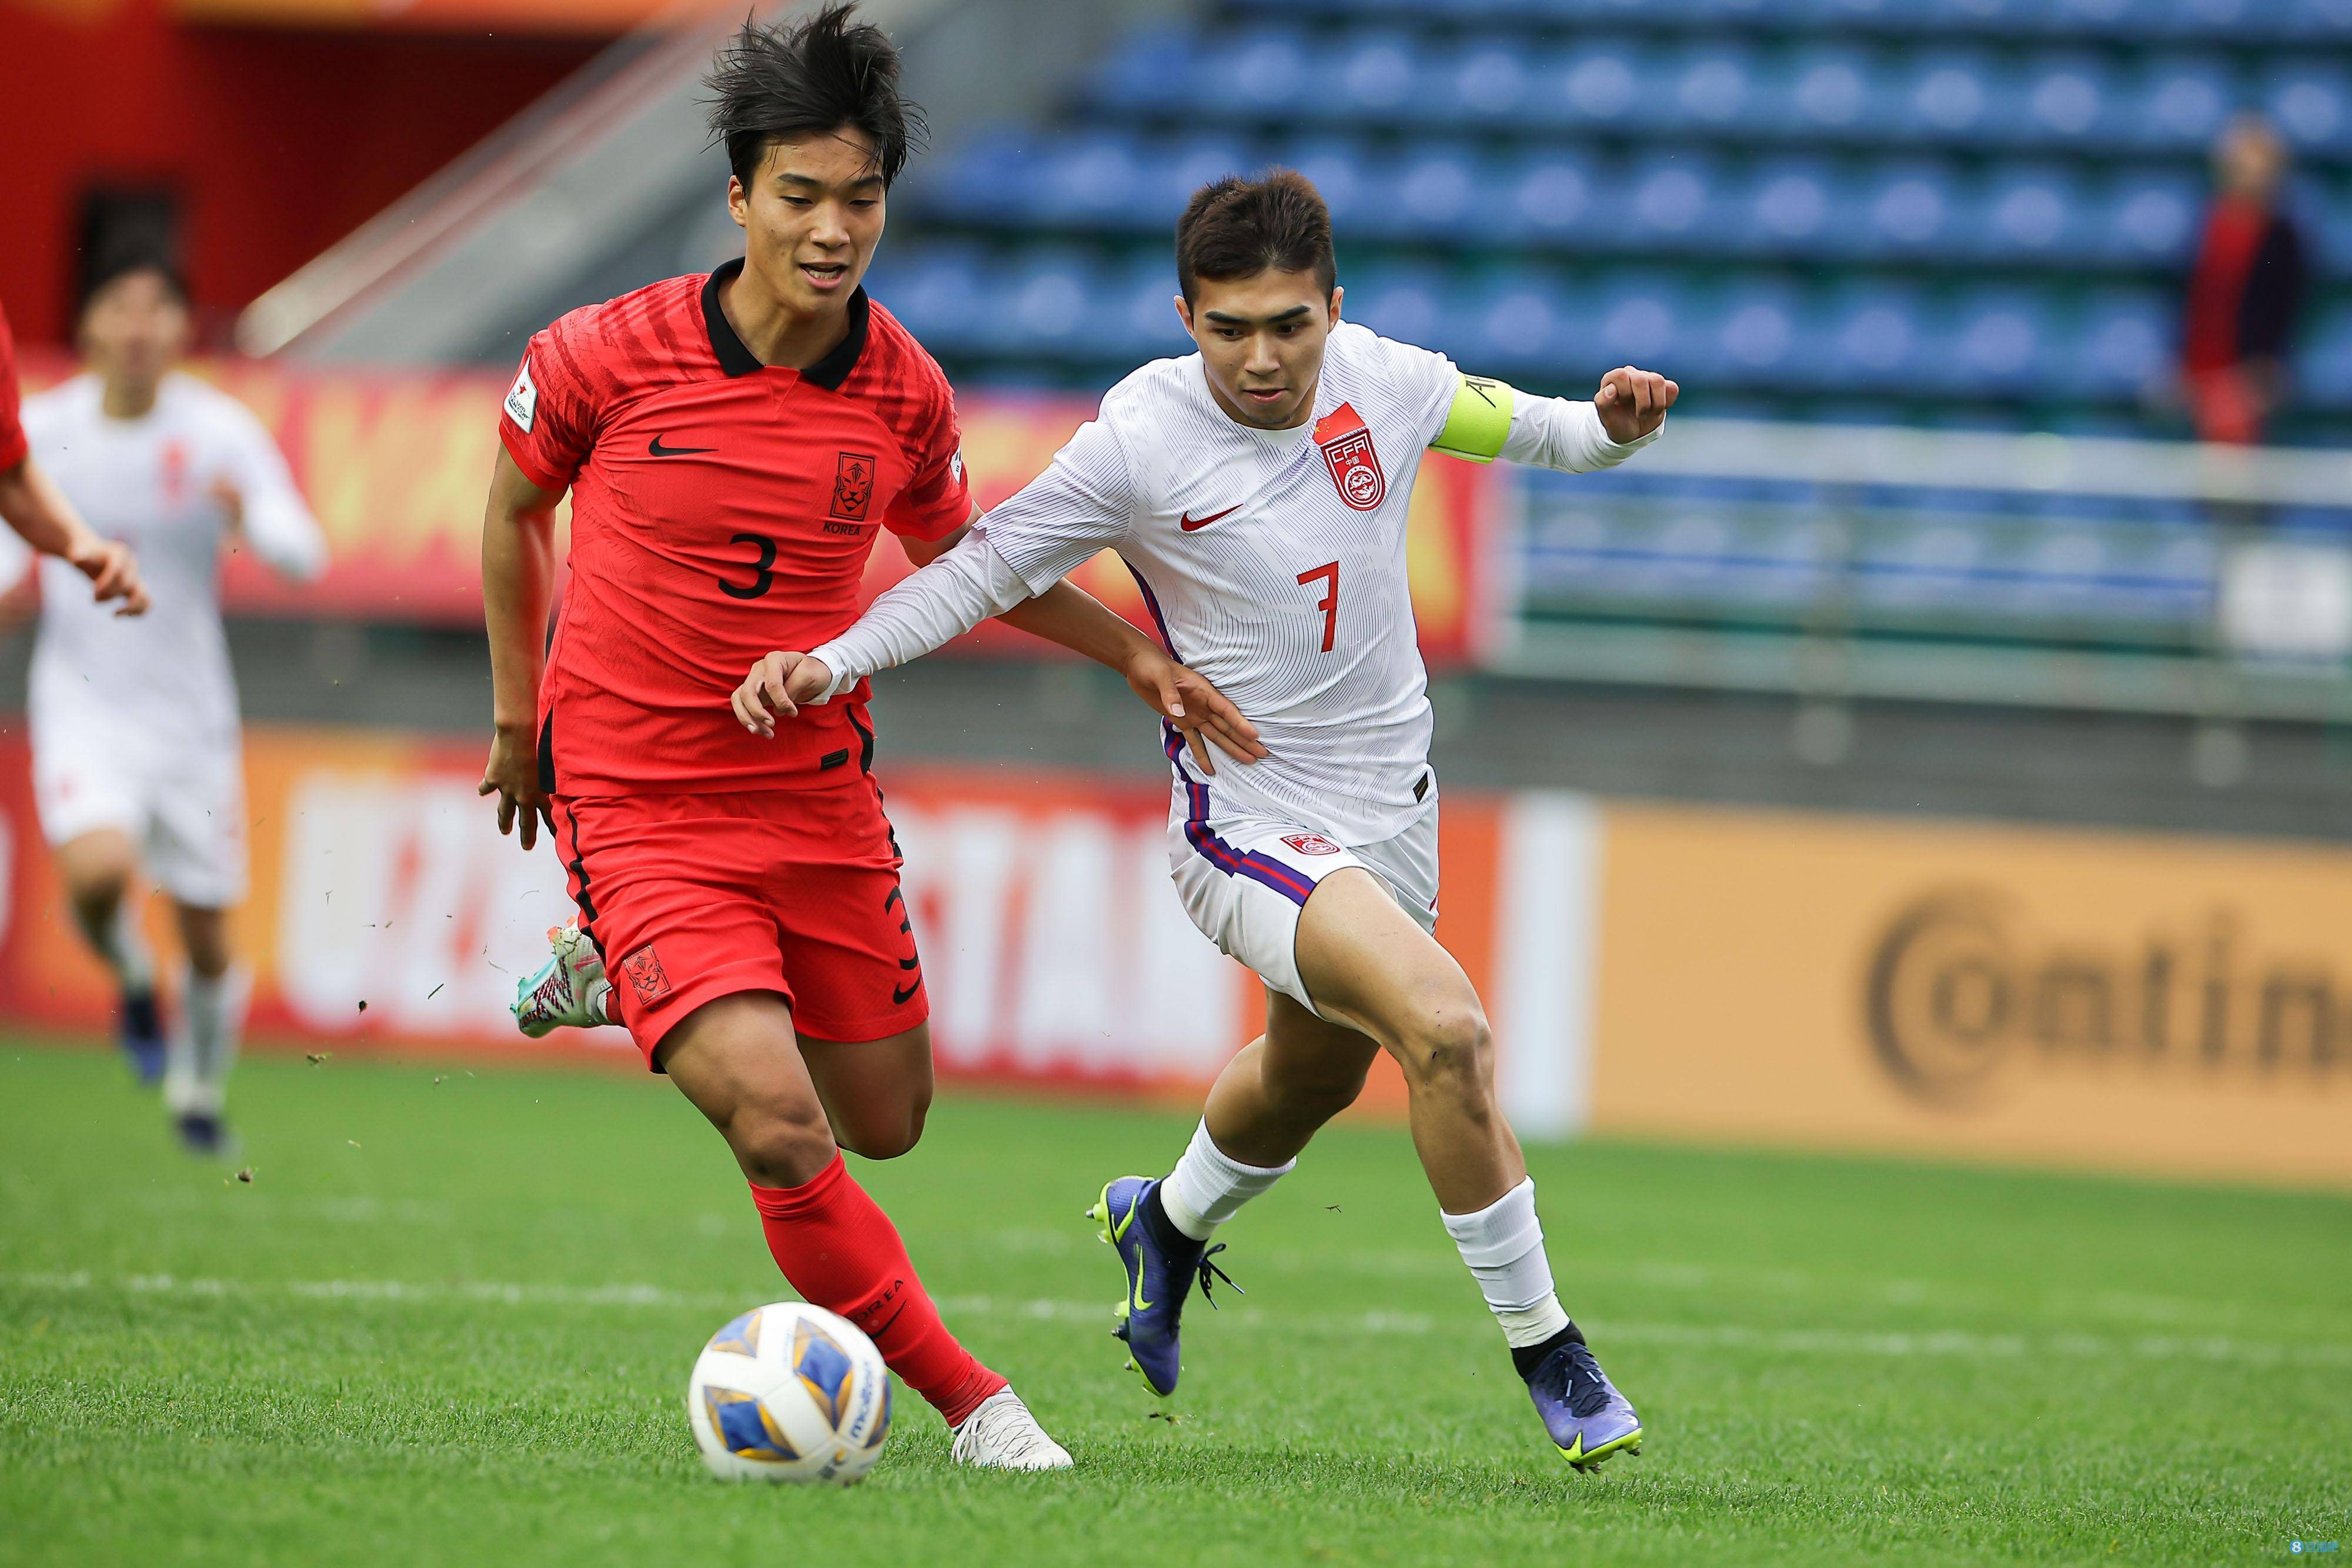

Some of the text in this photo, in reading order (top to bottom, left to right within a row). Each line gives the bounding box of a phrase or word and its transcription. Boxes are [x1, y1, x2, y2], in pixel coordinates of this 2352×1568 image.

[1331, 439, 1367, 464] CFA
[1345, 455, 1360, 467] 中国
[823, 521, 860, 536] KOREA
[717, 533, 777, 600] 3
[1296, 560, 1339, 653] 7
[884, 885, 918, 971] 3
[1863, 882, 2352, 1111] Contin
[851, 1279, 904, 1322] OREA
